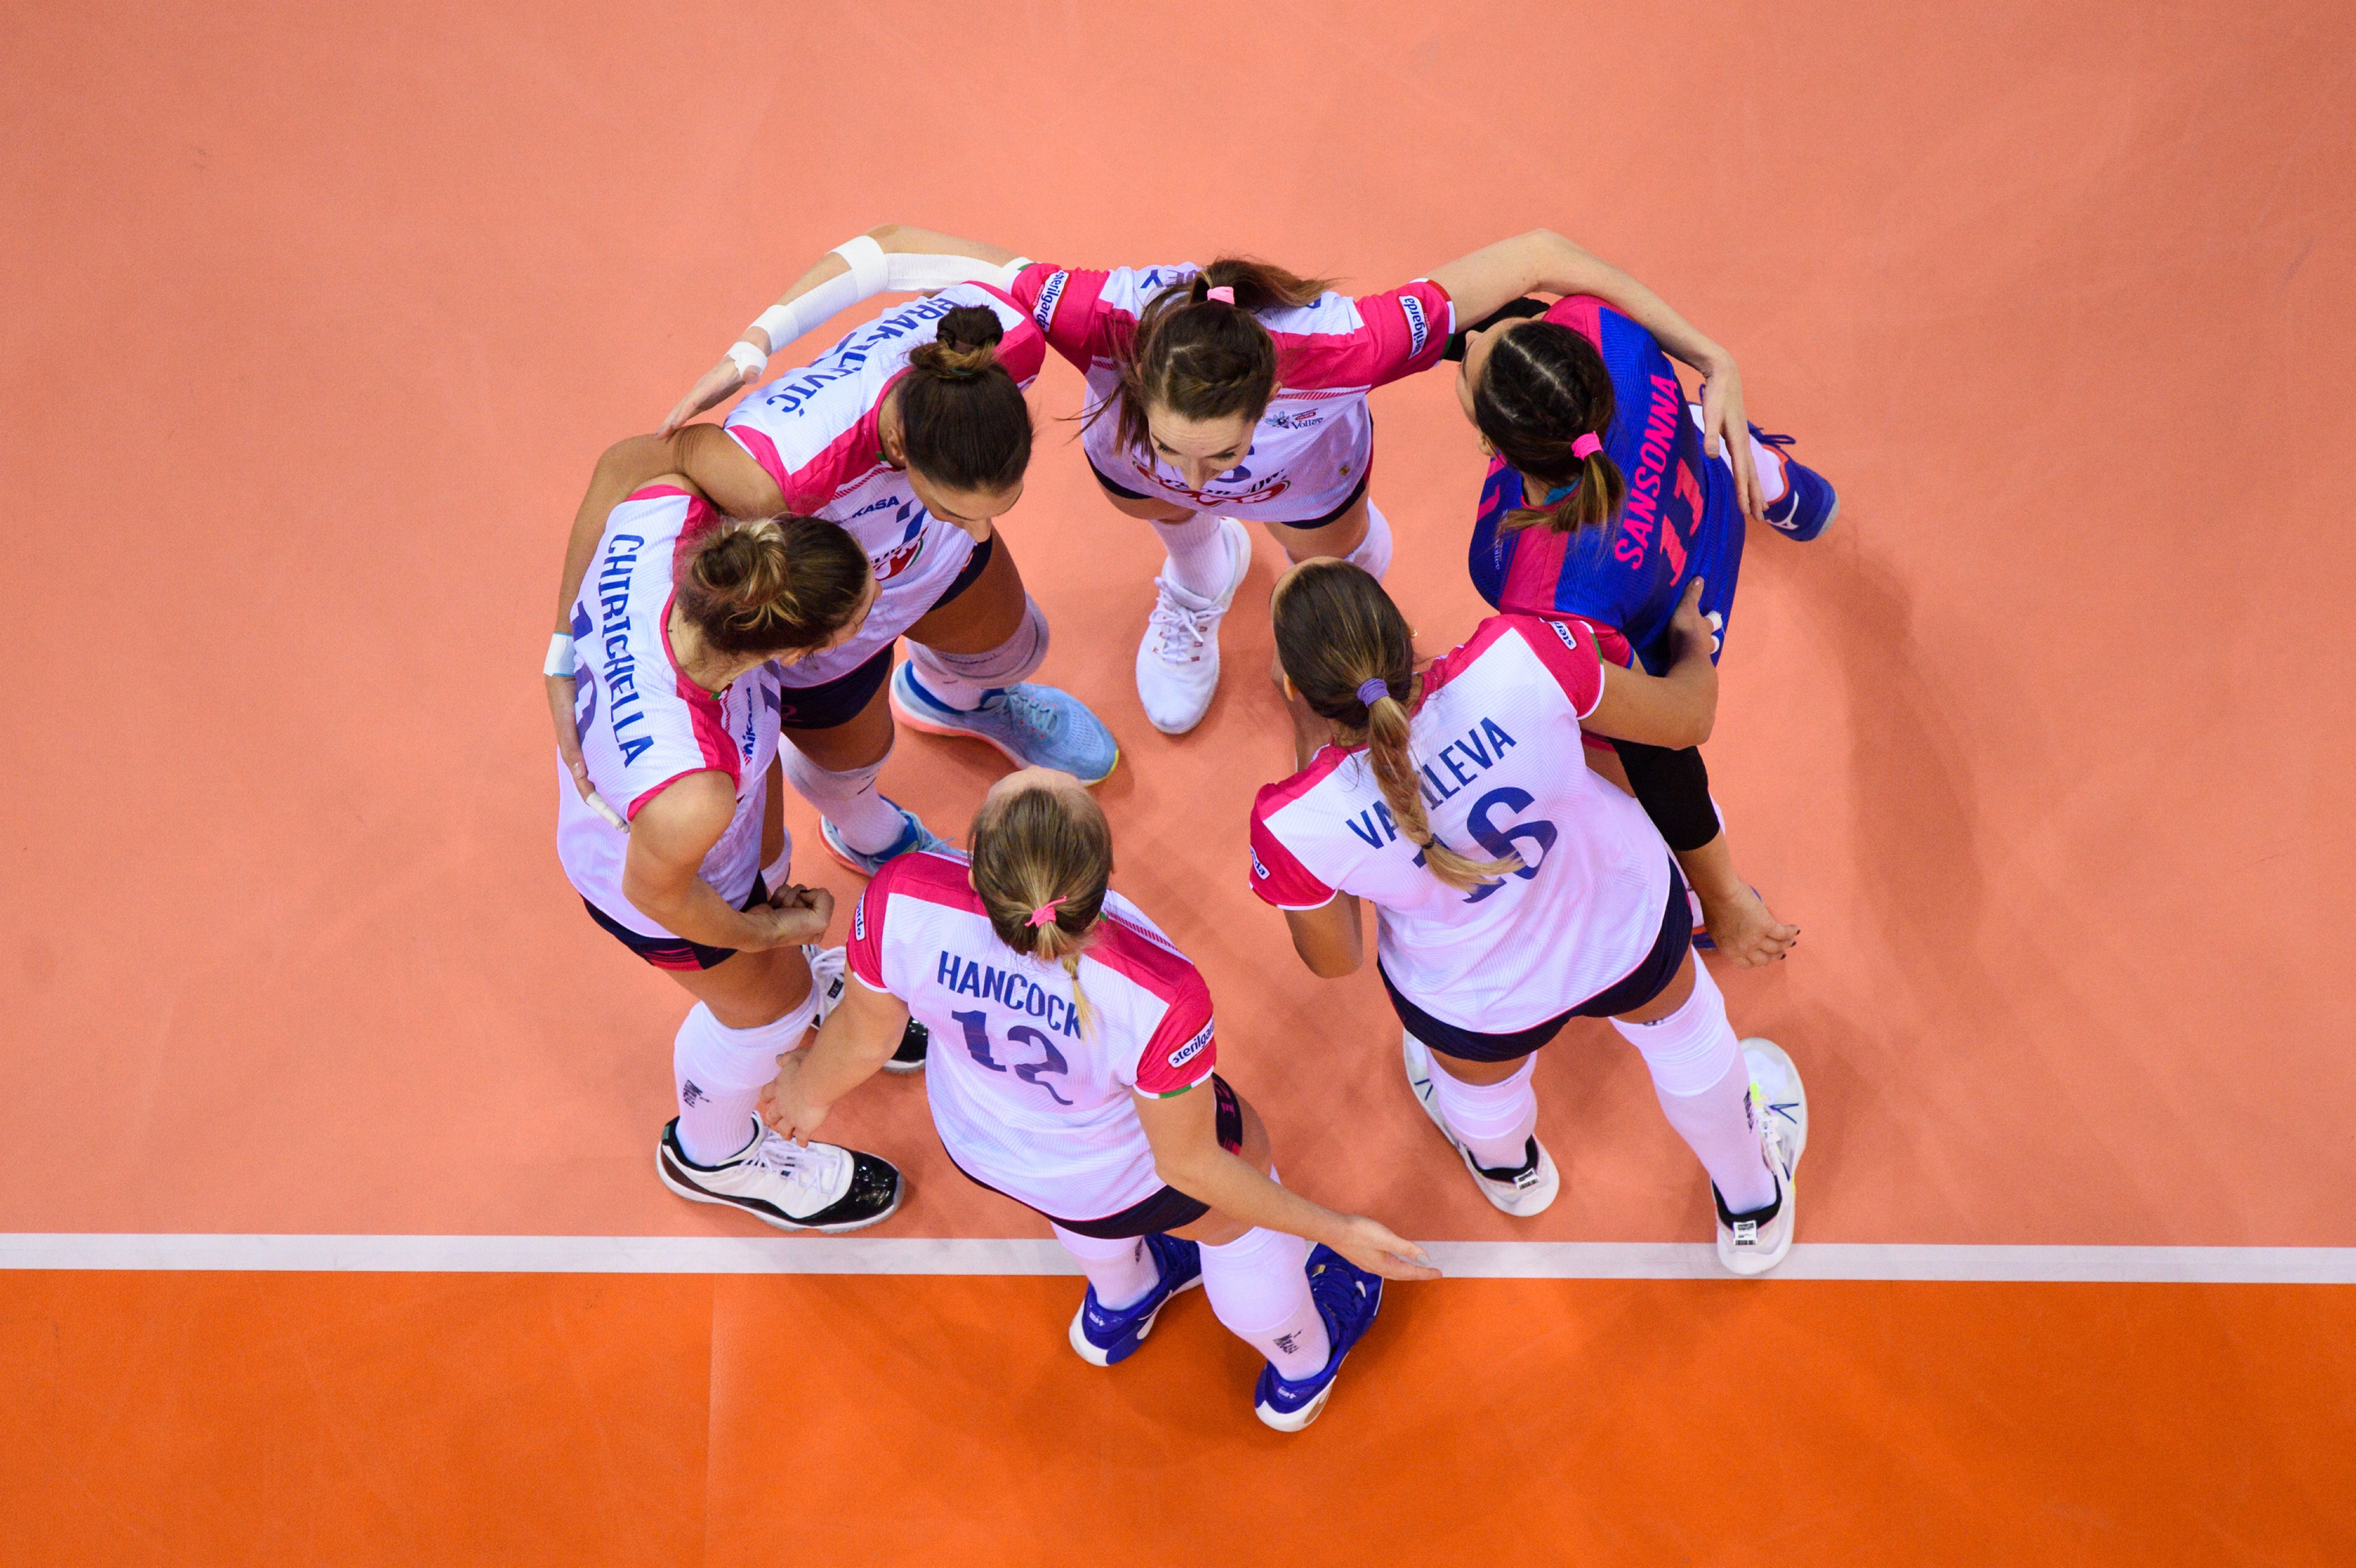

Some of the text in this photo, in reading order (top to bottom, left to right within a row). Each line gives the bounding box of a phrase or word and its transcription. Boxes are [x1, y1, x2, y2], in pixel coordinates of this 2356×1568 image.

[1614, 374, 1679, 570] SANSONNA
[1659, 457, 1704, 587] 11
[598, 534, 654, 768] CHIRICHELLA
[1344, 716, 1517, 850] VAILEVA
[937, 950, 1082, 1040] HANCOCK
[952, 1009, 1074, 1106] 12
